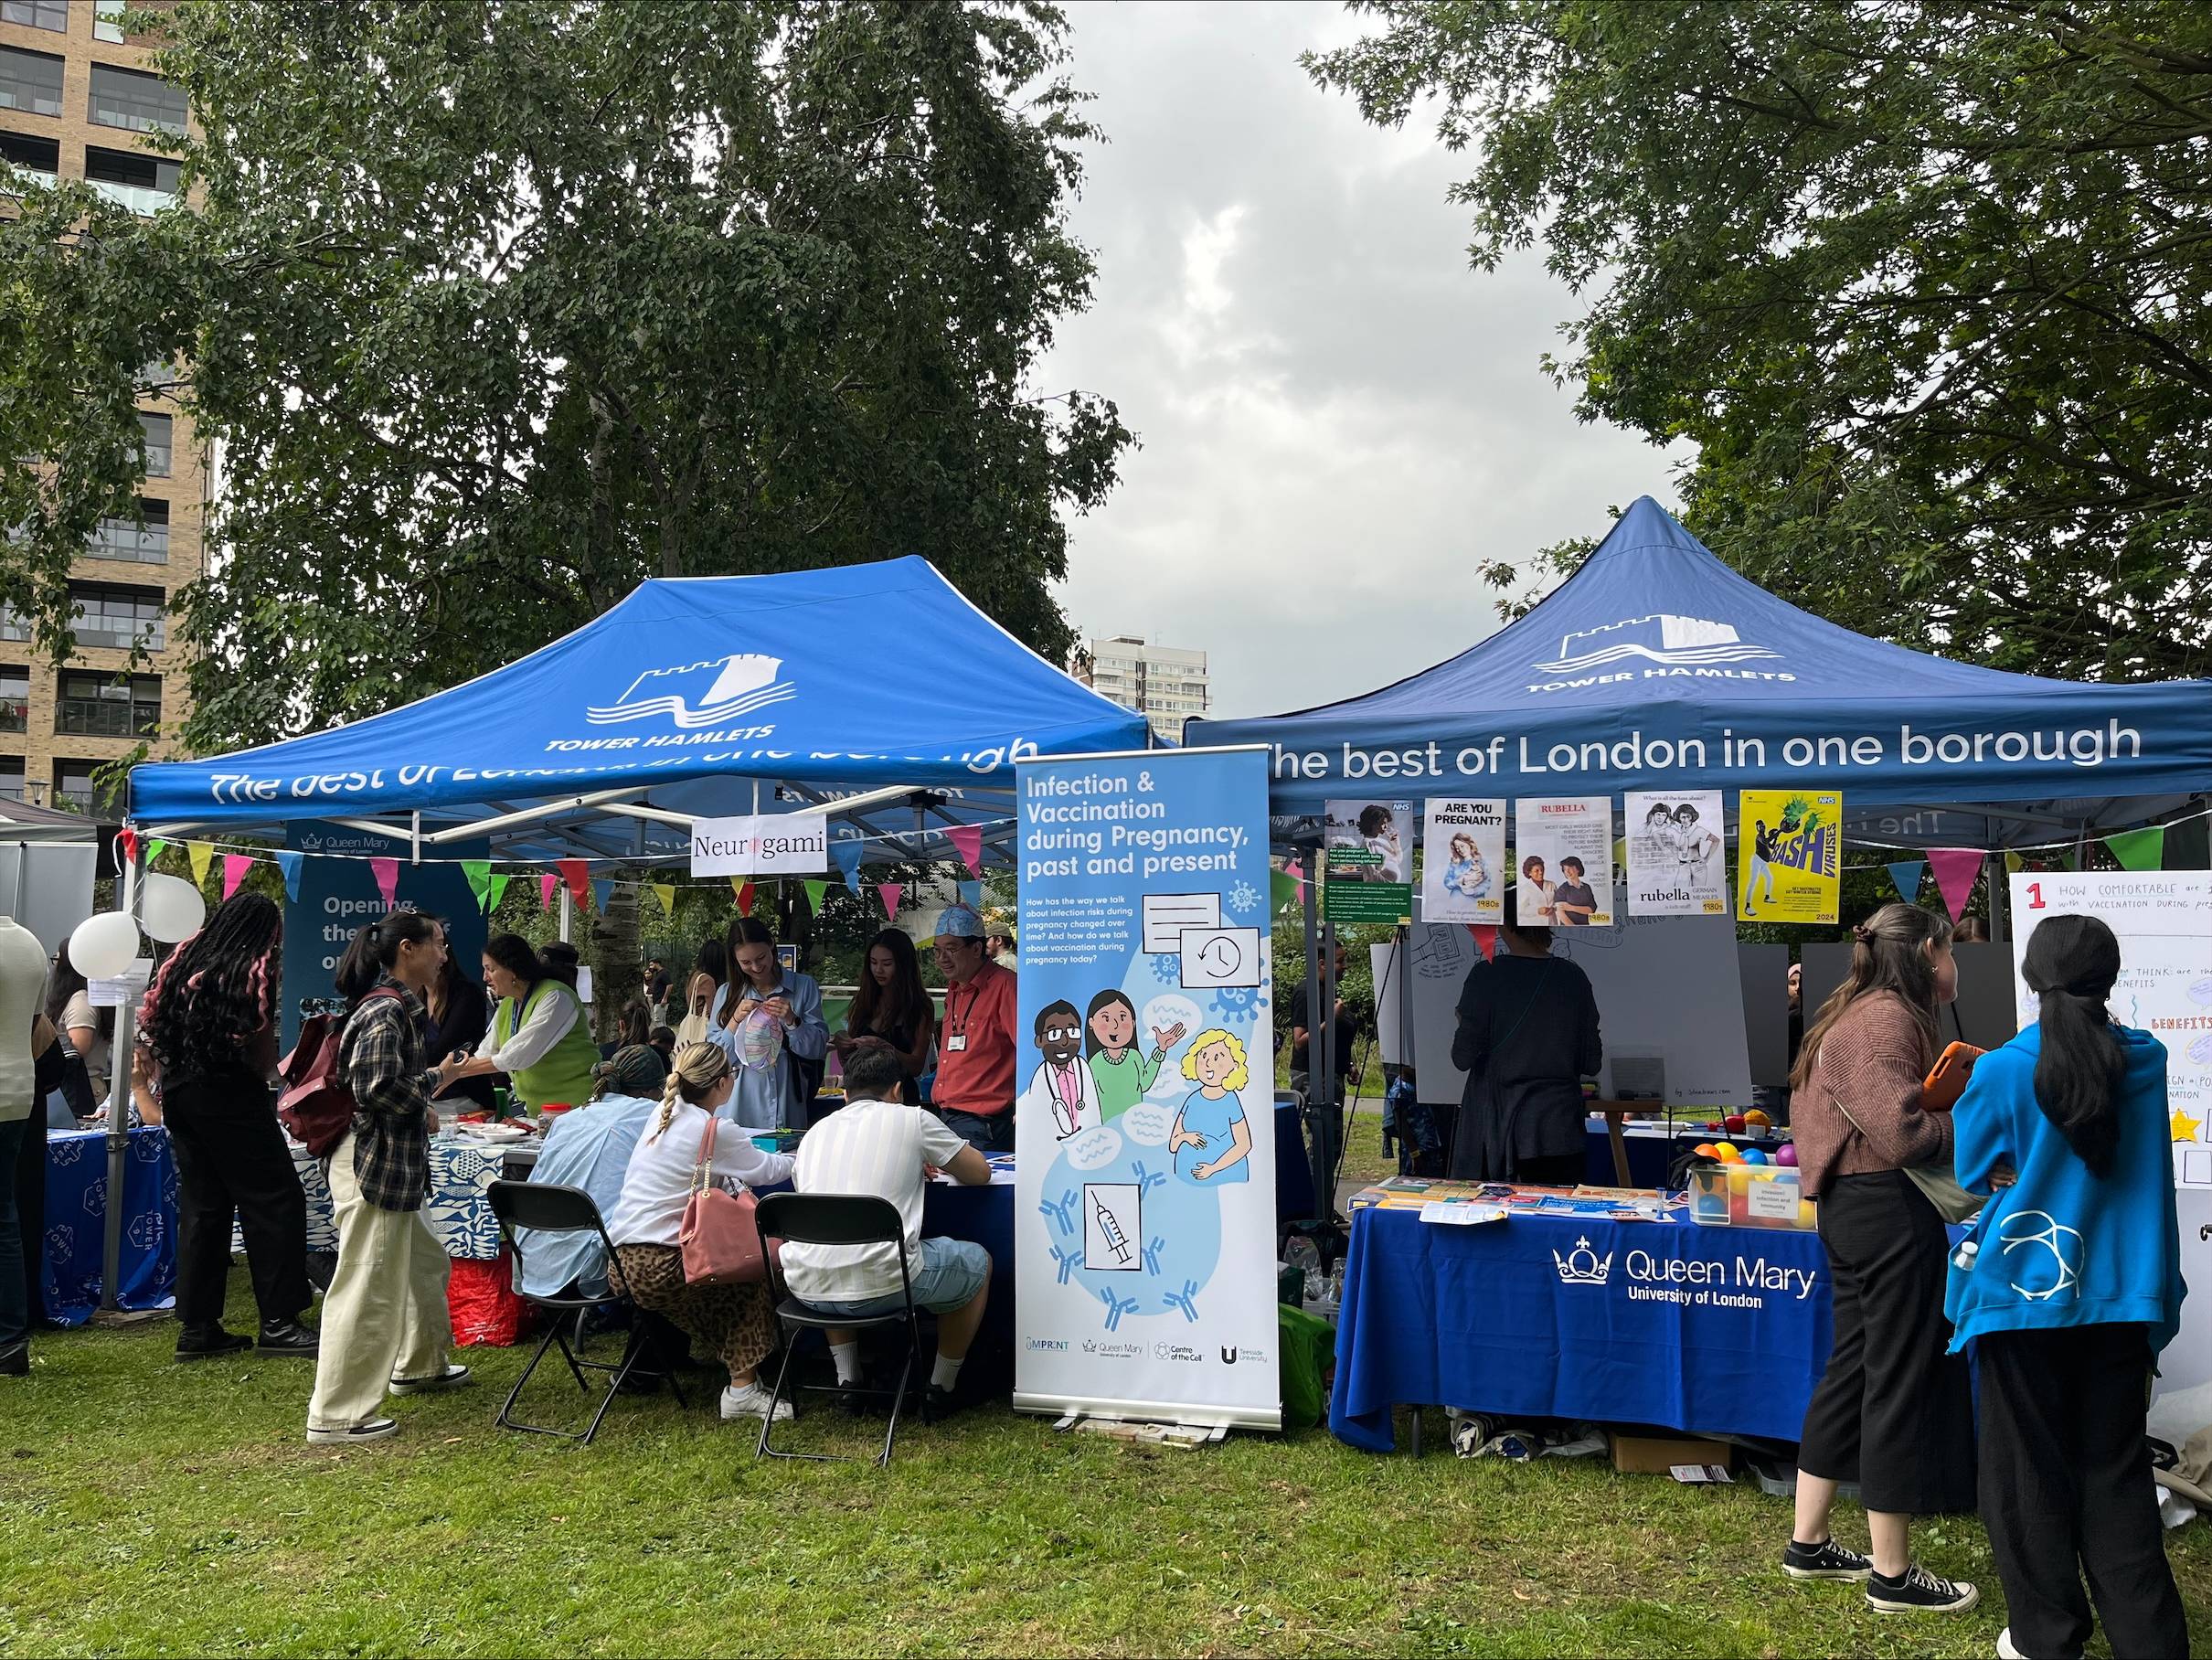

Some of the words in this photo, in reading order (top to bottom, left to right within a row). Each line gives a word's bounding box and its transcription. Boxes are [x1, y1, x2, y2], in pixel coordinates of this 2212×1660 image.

[1526, 671, 1634, 693] TOWER
[1643, 667, 1797, 682] HAMLETS
[544, 737, 640, 751] TOWER
[642, 724, 776, 748] HAMLETS
[1274, 742, 1330, 779] he
[1342, 740, 1443, 778] best
[1455, 736, 1506, 775] of
[1519, 730, 1707, 772] London
[1723, 729, 1766, 768] in
[1781, 735, 1884, 768] one
[1901, 718, 2142, 768] borough
[1026, 775, 1128, 798] Infection
[1137, 771, 1154, 793] &
[1026, 799, 1165, 824] Vaccination
[1392, 803, 1410, 812] NHS
[1445, 803, 1468, 813] ARE
[1471, 804, 1492, 813] YOU
[1541, 803, 1586, 813] RUBELLA
[1435, 815, 1502, 825] PREGNANT?
[326, 836, 361, 848] Queen
[364, 837, 389, 850] Mary
[1026, 828, 1102, 854] during
[1111, 825, 1249, 851] Pregnancy,
[1824, 823, 1836, 878] VIRUSES
[1026, 857, 1079, 883] past
[1086, 853, 1133, 875] and
[1143, 850, 1238, 878] present
[1026, 898, 1042, 906] How
[1061, 897, 1075, 905] the
[1110, 895, 1125, 903] talk
[1641, 888, 1690, 901] rubella
[2026, 882, 2046, 910] 1
[2058, 885, 2086, 896] HOW
[2098, 883, 2177, 895] COMFORTABLE
[2058, 899, 2079, 908] with
[2088, 899, 2148, 909] VACCINATION
[2156, 899, 2189, 909] DURING
[1050, 909, 1085, 917] infection
[1087, 908, 1104, 916] risks
[1106, 907, 1133, 917] during
[1026, 920, 1068, 931] pregnancy
[1069, 920, 1105, 930] changed
[1026, 932, 1046, 941] time?
[1067, 931, 1084, 940] how
[1113, 931, 1129, 939] talk
[1026, 944, 1048, 952] about
[1050, 942, 1097, 952] vaccination
[1099, 942, 1125, 952] during
[1026, 956, 1068, 966] pregnancy
[1069, 954, 1098, 964] today?
[144, 1210, 154, 1250] TOWER
[46, 1228, 73, 1259] TOWER
[1626, 1250, 1726, 1285] Queen
[1735, 1256, 1816, 1300] Mary
[1628, 1285, 1691, 1306] University
[1695, 1291, 1708, 1305] of
[1712, 1292, 1762, 1309] London
[1100, 1343, 1123, 1353] Queen
[1124, 1344, 1143, 1354] Mary
[1171, 1346, 1193, 1354] Centre
[1239, 1355, 1268, 1363] University
